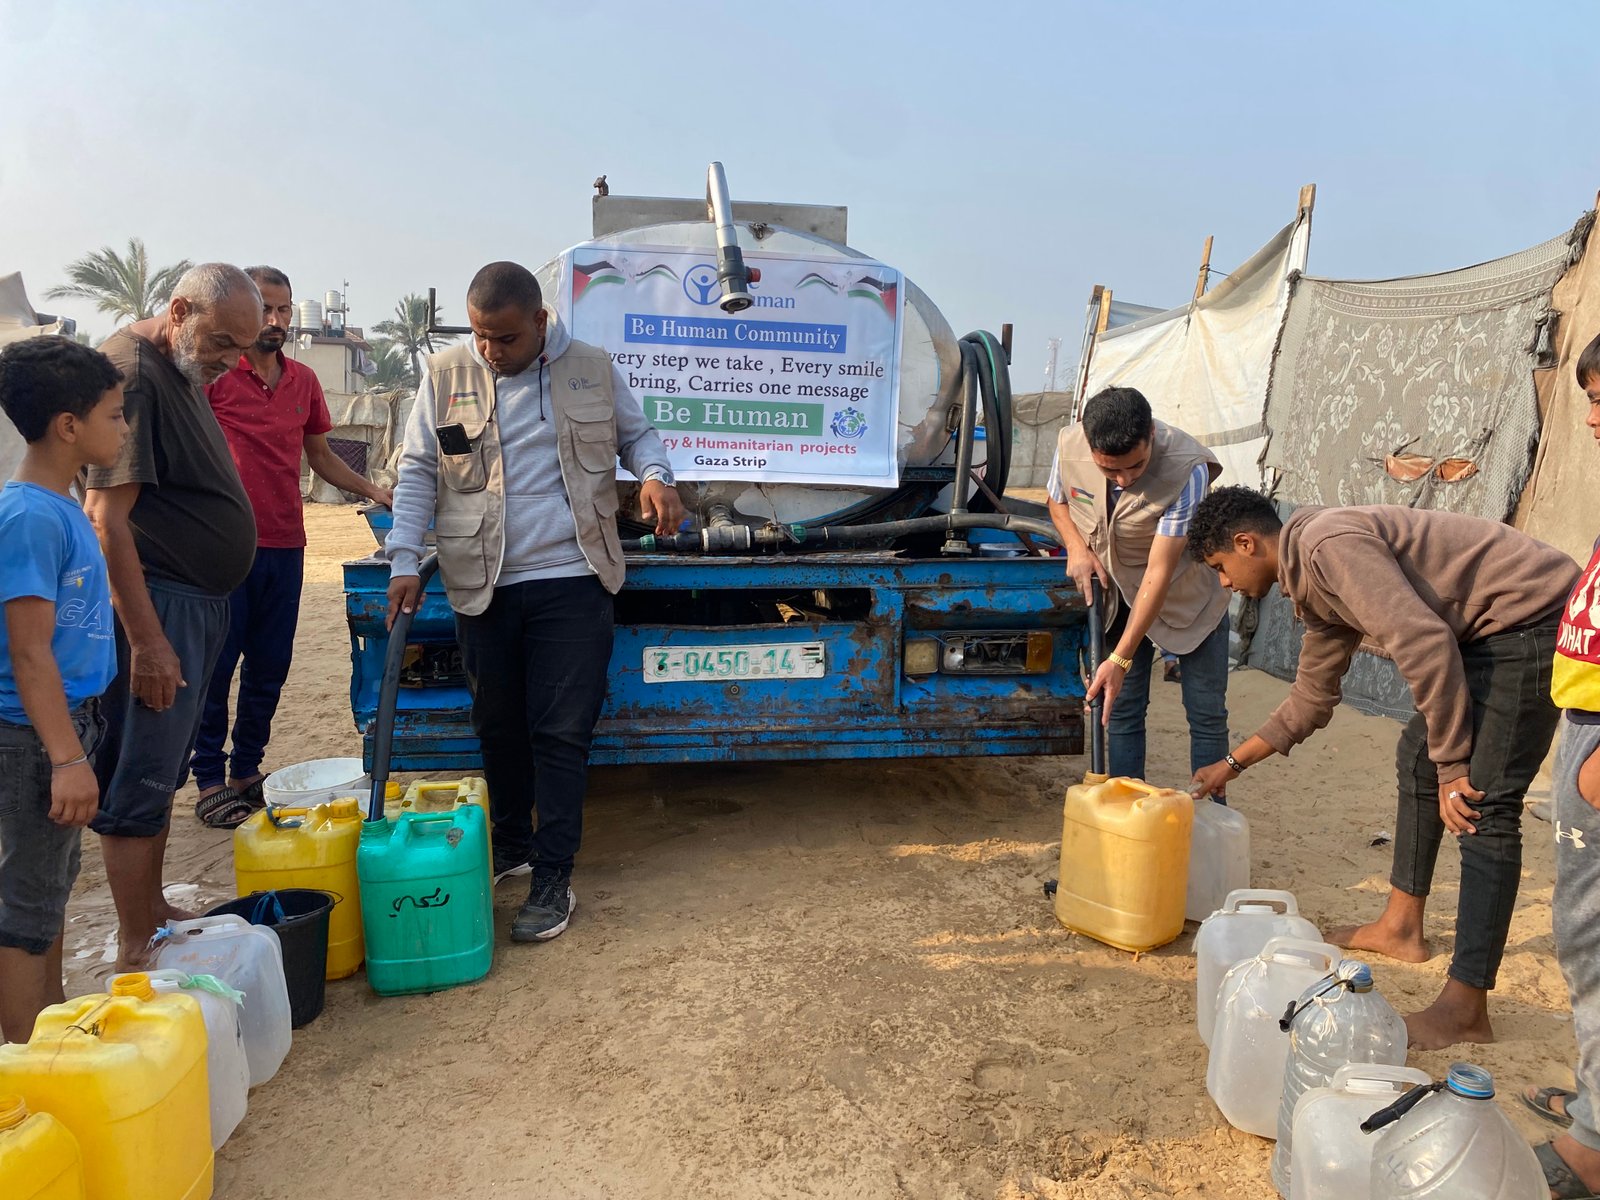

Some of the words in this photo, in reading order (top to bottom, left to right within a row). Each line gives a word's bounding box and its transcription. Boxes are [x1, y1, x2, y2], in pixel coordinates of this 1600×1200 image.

[631, 317, 655, 336] Be
[661, 320, 728, 340] Human
[734, 323, 840, 349] Community
[609, 352, 646, 369] very
[652, 353, 688, 371] step
[695, 357, 720, 369] we
[726, 355, 763, 371] take
[781, 357, 833, 378] Every
[838, 361, 884, 377] smile
[629, 373, 681, 393] bring,
[688, 375, 753, 393] Carries
[759, 382, 791, 395] one
[797, 384, 869, 401] message
[654, 400, 691, 423] Be
[702, 402, 808, 429] Human
[682, 437, 692, 448] &
[696, 437, 793, 452] Humanitarian
[800, 442, 857, 456] projects
[694, 455, 729, 466] Gaza
[733, 456, 767, 468] Strip
